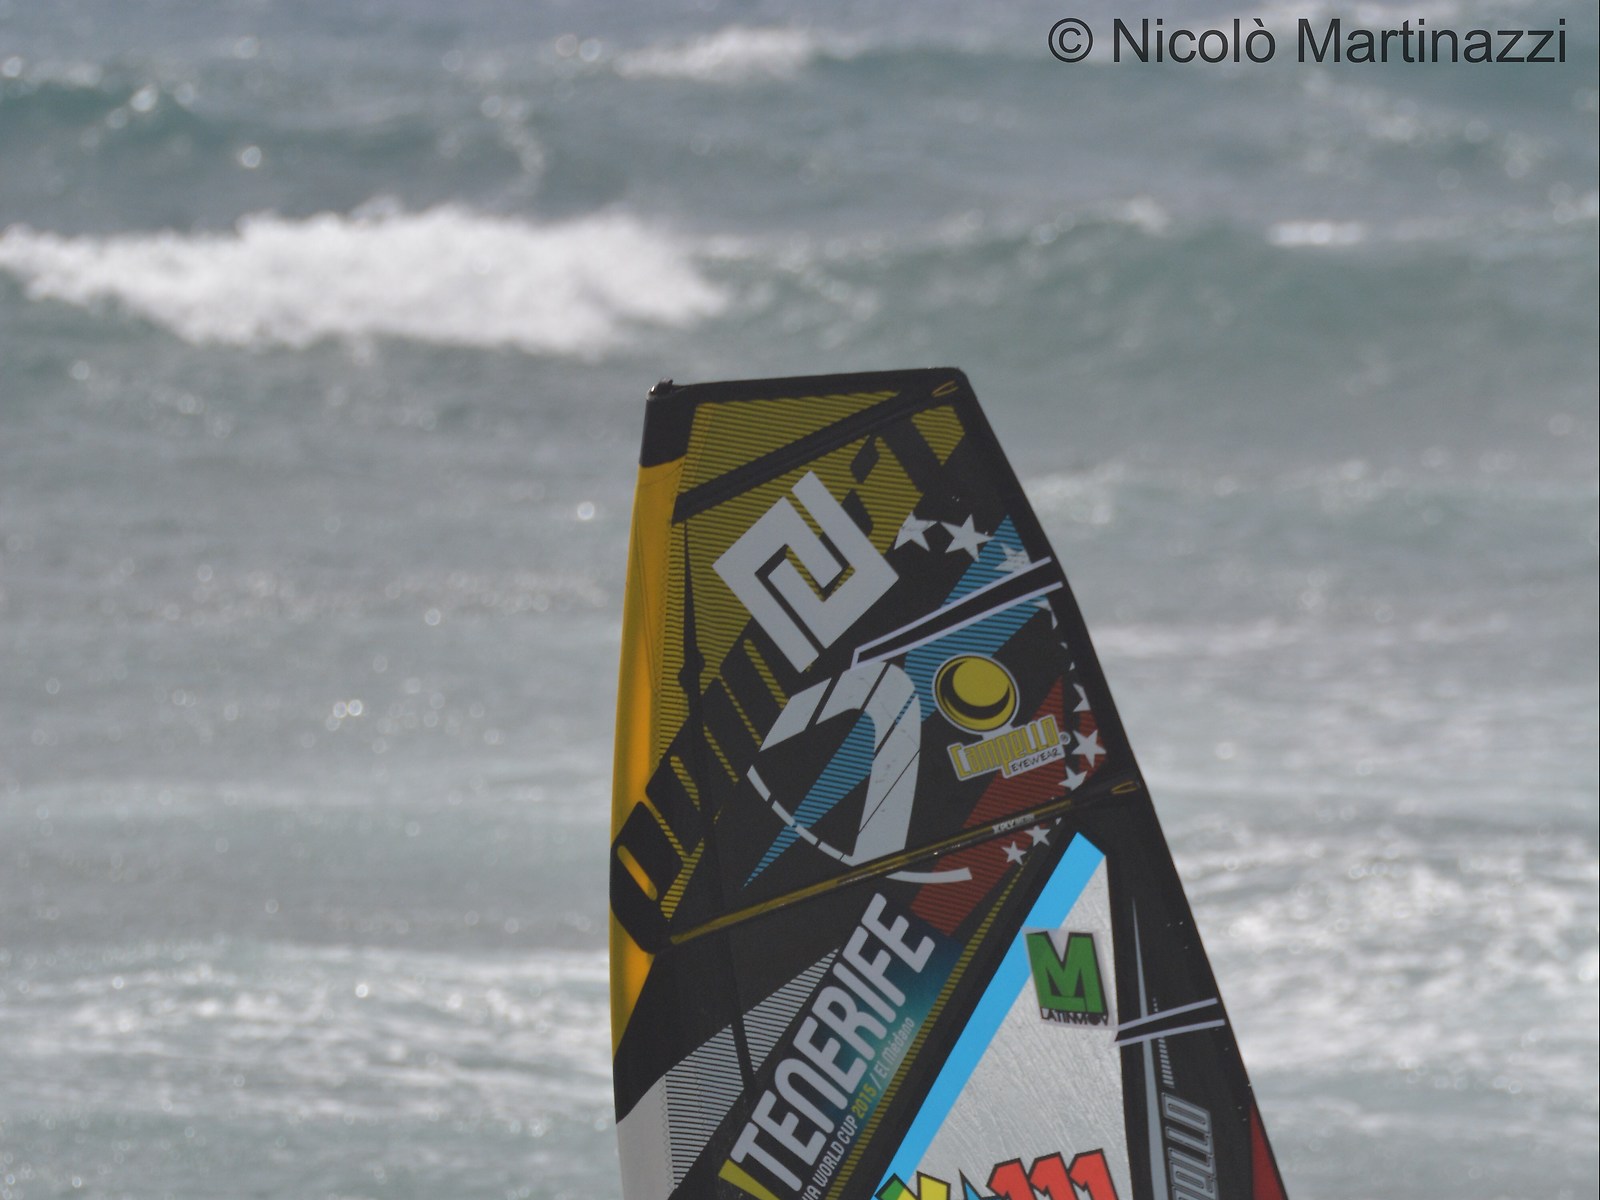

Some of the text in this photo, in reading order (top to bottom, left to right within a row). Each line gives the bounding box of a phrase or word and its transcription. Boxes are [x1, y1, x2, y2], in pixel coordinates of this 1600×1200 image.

[1010, 747, 1061, 773] EYEWEAR
[813, 1141, 845, 1190] WORLD
[837, 1114, 857, 1144] CUP
[852, 1084, 878, 1119] 2015
